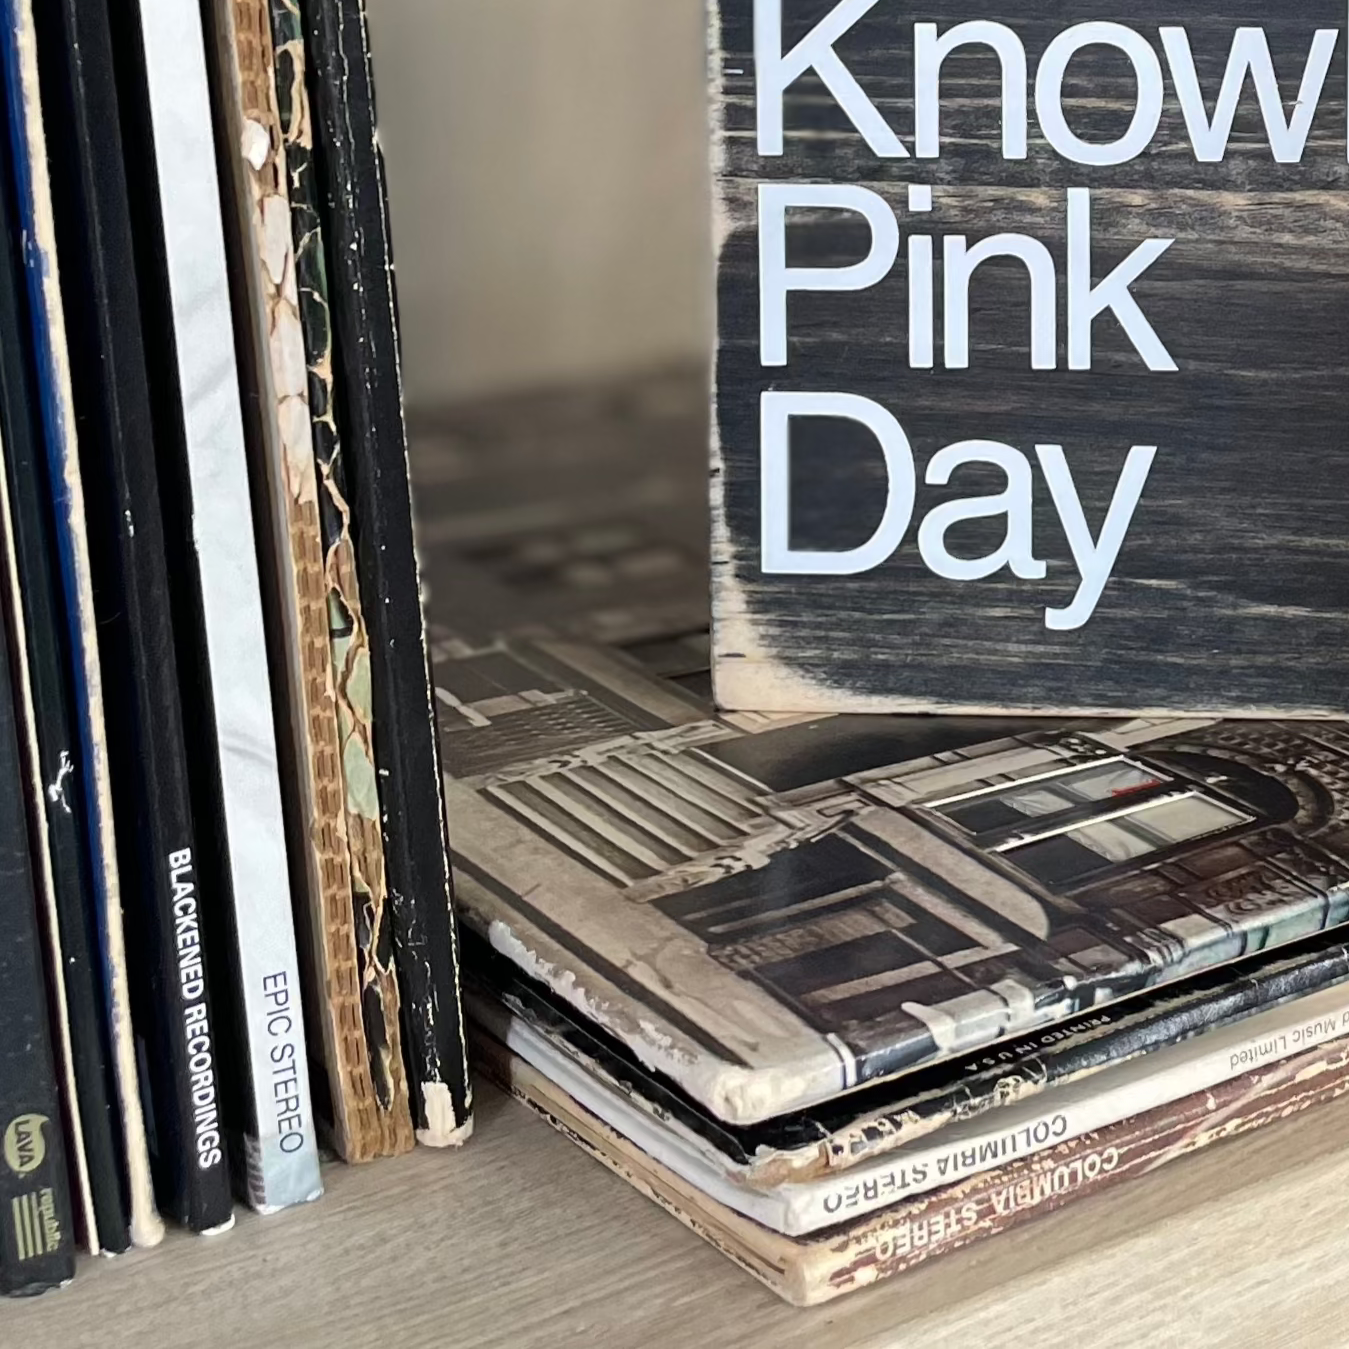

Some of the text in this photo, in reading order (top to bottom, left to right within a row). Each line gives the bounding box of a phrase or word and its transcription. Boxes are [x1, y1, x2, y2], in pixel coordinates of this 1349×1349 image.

[757, 183, 1179, 371] Pink
[760, 391, 1157, 630] Day
[168, 846, 223, 1169] BLACKENED RECORDINGS
[1014, 1040, 1038, 1055] IN
[1040, 1014, 1112, 1046] PRINTED
[1289, 1014, 1338, 1046] Music
[262, 969, 305, 1156] EPIC STEREO
[1228, 1032, 1289, 1071] Limited
[13, 1118, 38, 1169] LAVA
[821, 1112, 1068, 1215] COLUMBIA STEREO
[37, 1186, 64, 1253] republic
[874, 1146, 1120, 1259] COLUMBIA STEREO
